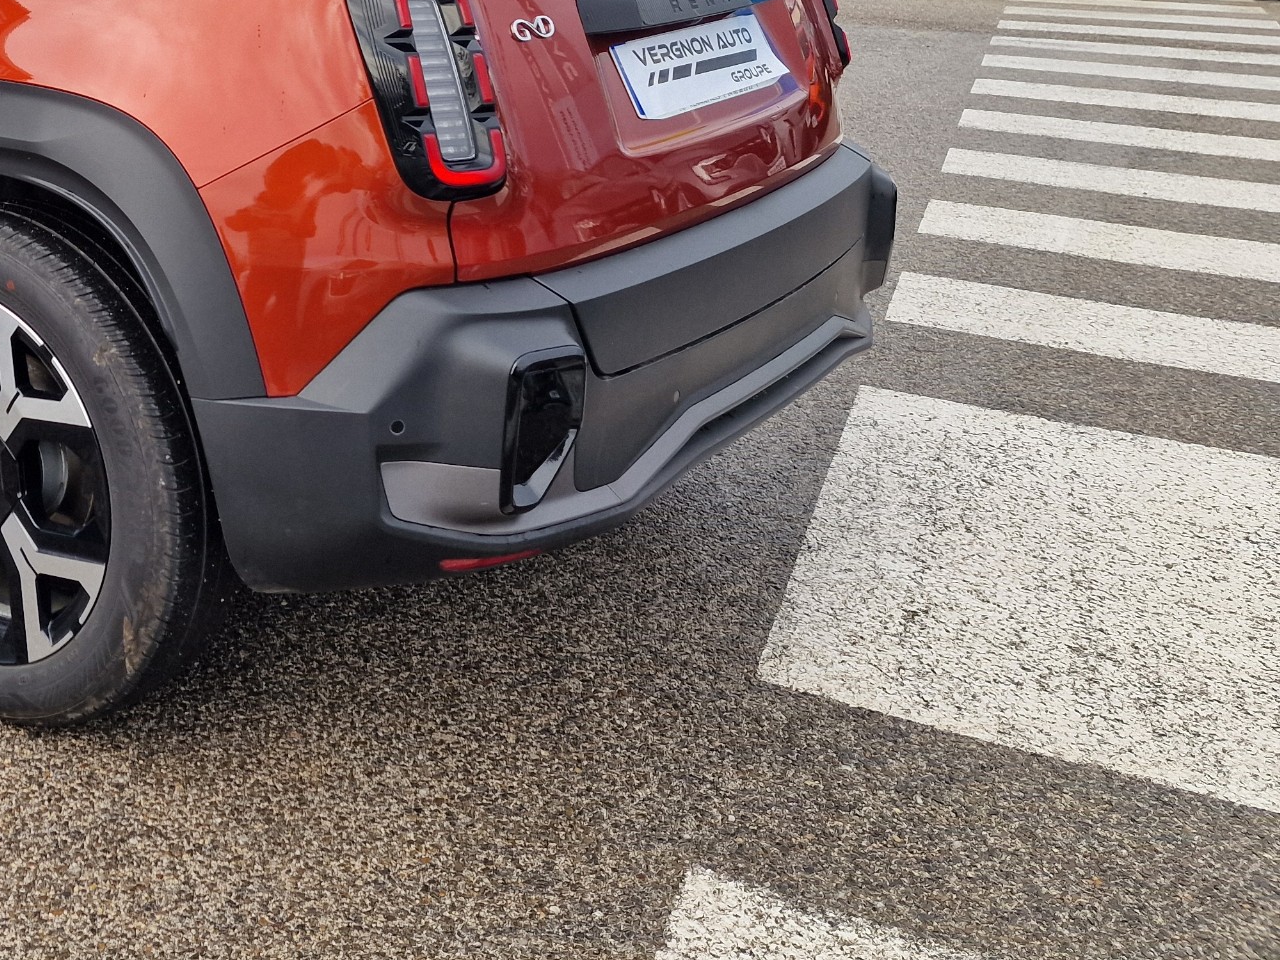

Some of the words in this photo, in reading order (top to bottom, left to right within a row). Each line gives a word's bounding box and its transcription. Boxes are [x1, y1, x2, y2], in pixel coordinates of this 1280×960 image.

[631, 34, 715, 67] VERGNON
[717, 26, 753, 50] AUTO
[730, 63, 773, 83] GROUPE
